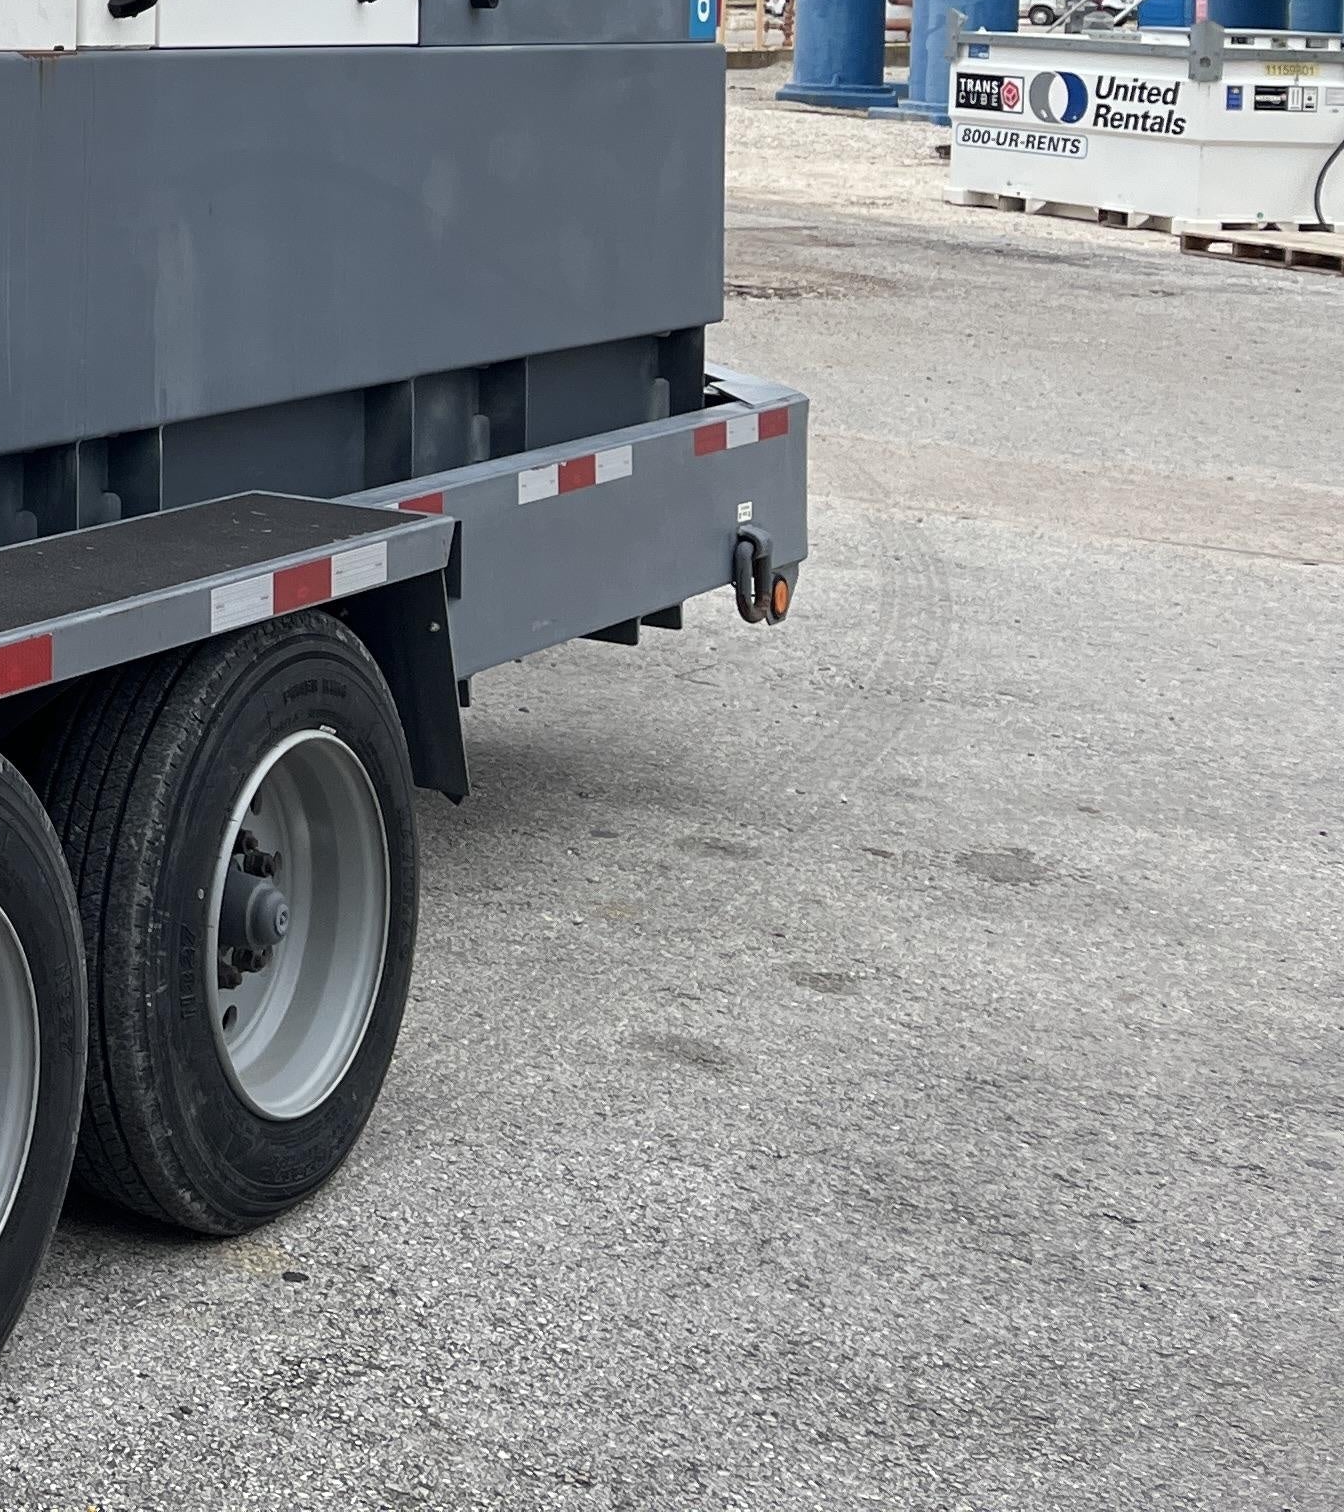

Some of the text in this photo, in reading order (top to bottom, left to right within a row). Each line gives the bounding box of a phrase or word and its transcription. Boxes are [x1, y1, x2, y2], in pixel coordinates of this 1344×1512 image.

[959, 78, 999, 93] TRANS
[1095, 75, 1180, 106] United
[958, 92, 999, 107] CUBE
[1093, 104, 1186, 135] Rentals
[961, 128, 1081, 154] 800-UR-RENTS
